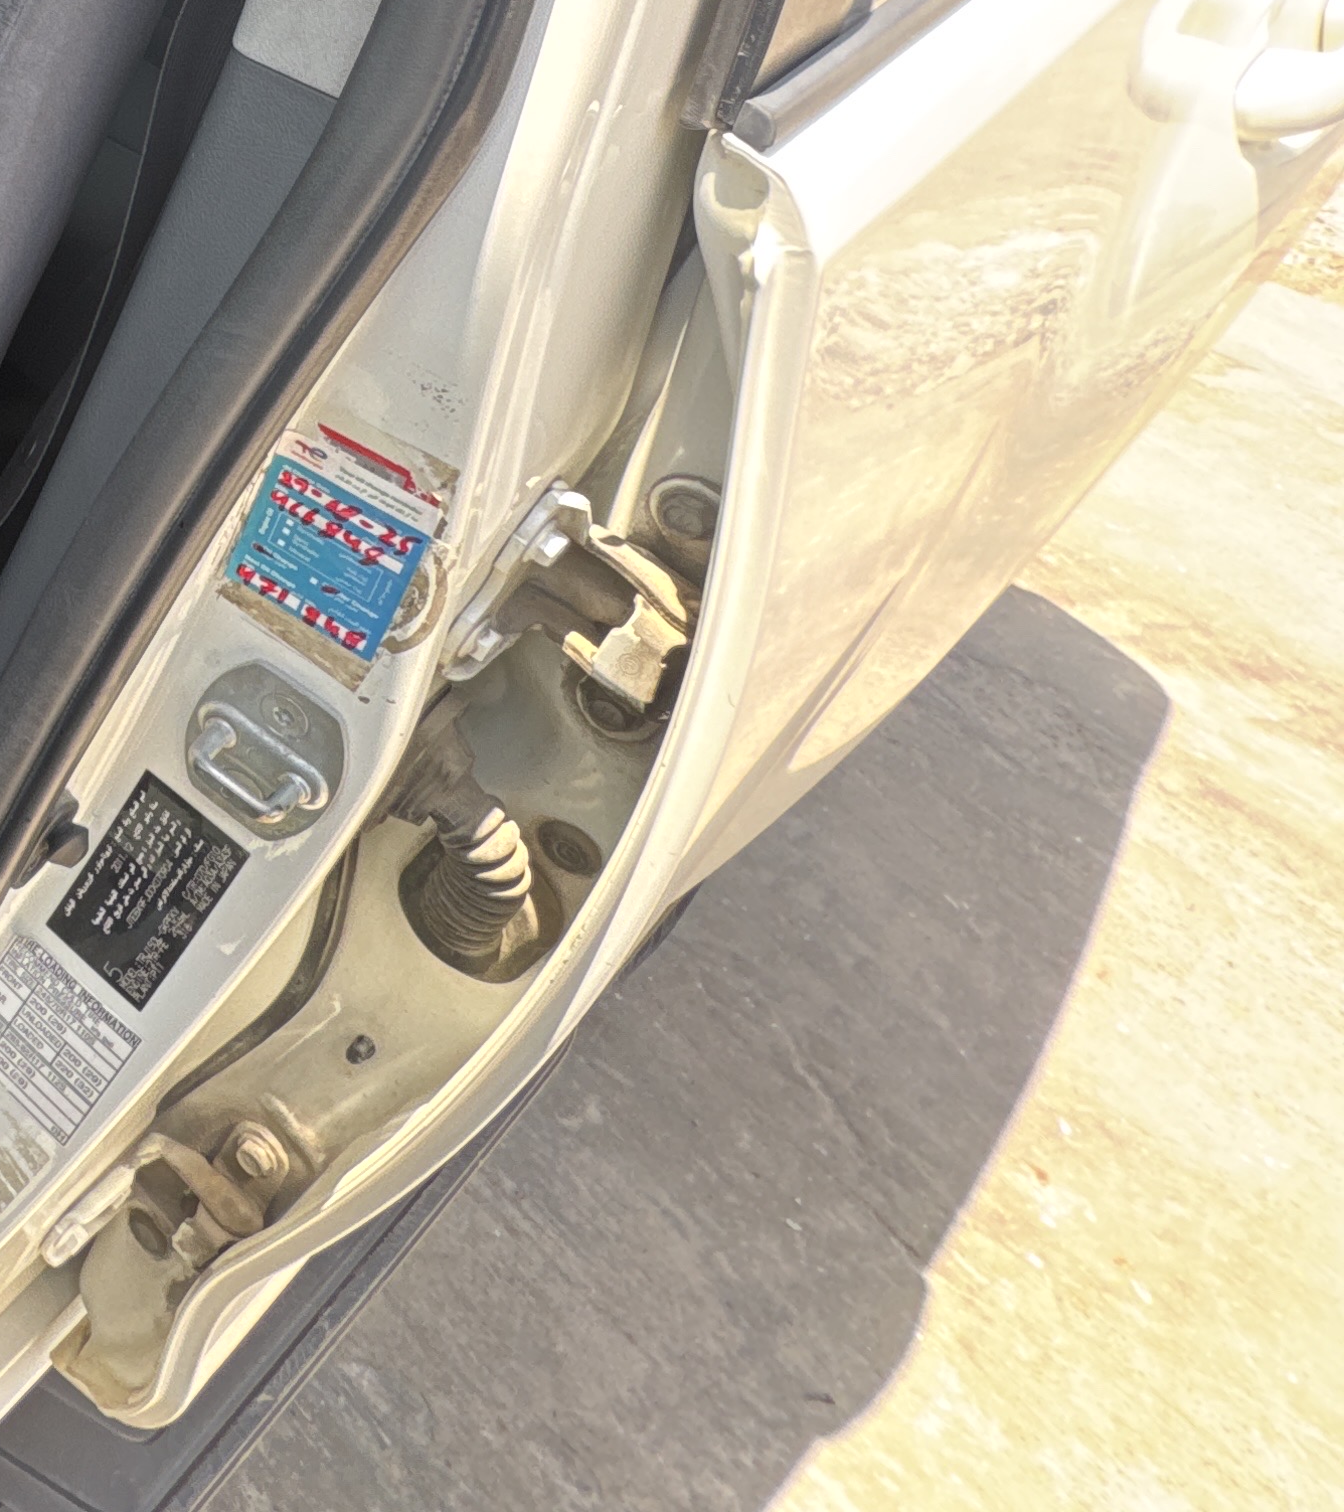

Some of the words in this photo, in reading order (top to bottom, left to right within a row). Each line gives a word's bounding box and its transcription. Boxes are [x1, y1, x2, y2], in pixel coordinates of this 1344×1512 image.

[100, 957, 125, 984] 5
[28, 995, 49, 1017] 200
[76, 986, 139, 1048] INFORMATION
[12, 1017, 45, 1051] LOADED
[19, 1005, 63, 1050] UNLOADED
[61, 1046, 83, 1070] 200
